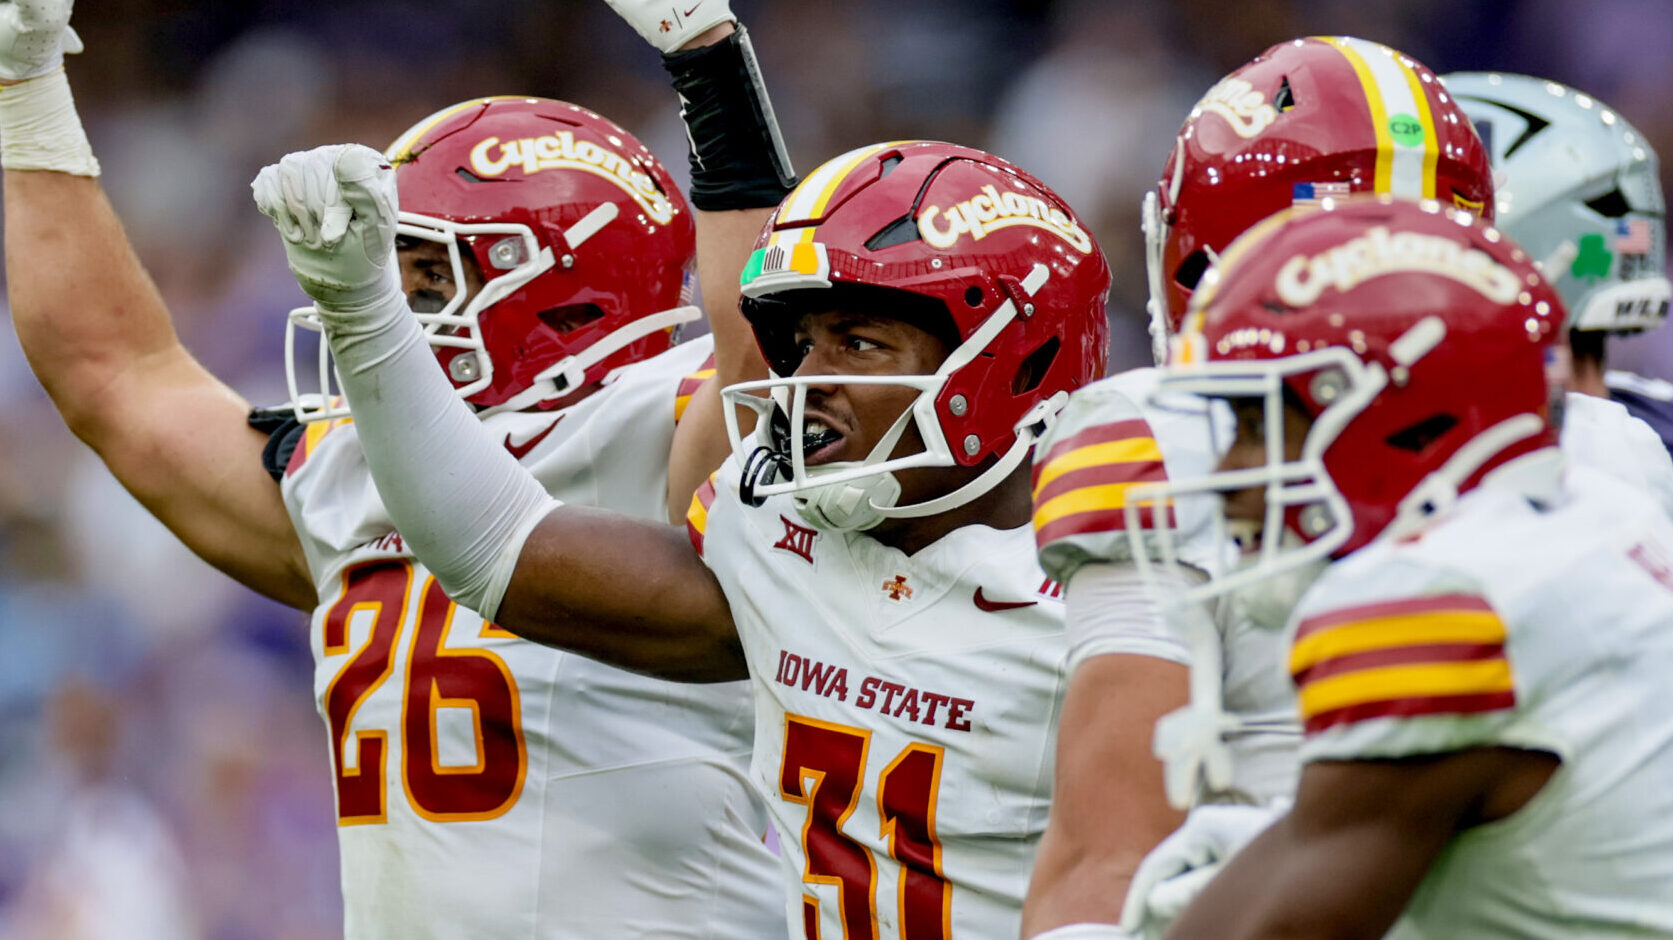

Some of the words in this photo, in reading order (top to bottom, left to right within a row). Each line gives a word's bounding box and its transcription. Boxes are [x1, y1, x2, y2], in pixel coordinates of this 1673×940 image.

[1391, 121, 1422, 135] C2P
[470, 130, 673, 226] Cyclones
[917, 184, 1093, 254] Cyclones
[773, 514, 819, 565] XII
[322, 557, 529, 827] 26
[776, 650, 848, 701] IOWA
[856, 676, 975, 732] STATE
[779, 712, 953, 940] 31
